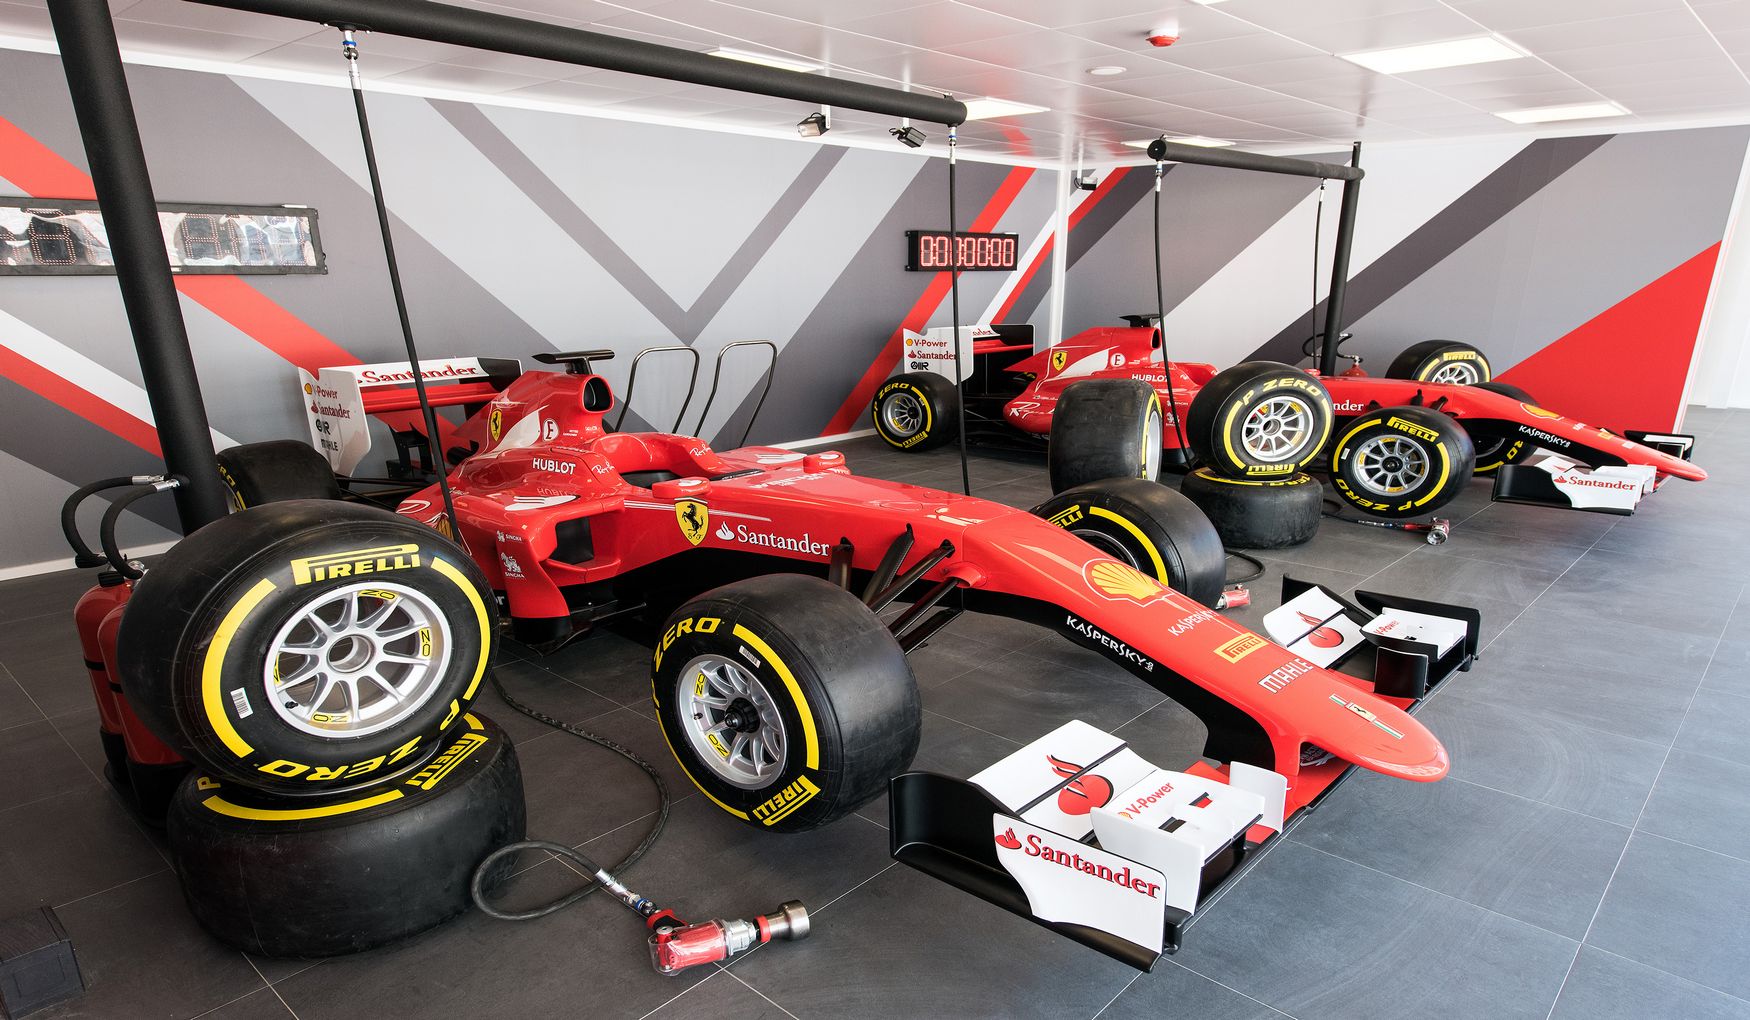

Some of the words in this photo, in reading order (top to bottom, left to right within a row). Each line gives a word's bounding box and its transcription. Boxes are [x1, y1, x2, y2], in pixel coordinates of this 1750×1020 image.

[879, 382, 910, 399] ZERO
[1262, 377, 1322, 397] ZERO
[1387, 416, 1440, 443] PIRELLI
[532, 457, 576, 476] HUBLOT
[1568, 476, 1637, 491] Santander
[1335, 478, 1390, 511] ZERO
[736, 524, 830, 557] Santander
[290, 543, 421, 587] PIRELLI
[654, 617, 721, 673] ZERO
[1066, 615, 1147, 666] KASPERSKY
[1221, 635, 1262, 659] PIRELLI
[1257, 658, 1314, 694] MAHLE
[440, 698, 460, 731] P
[257, 735, 423, 781] ZERO
[405, 732, 489, 791] PIRELLI
[752, 774, 822, 827] PIRELLI
[1127, 781, 1175, 820] V-Power
[1024, 833, 1161, 900] Santander
